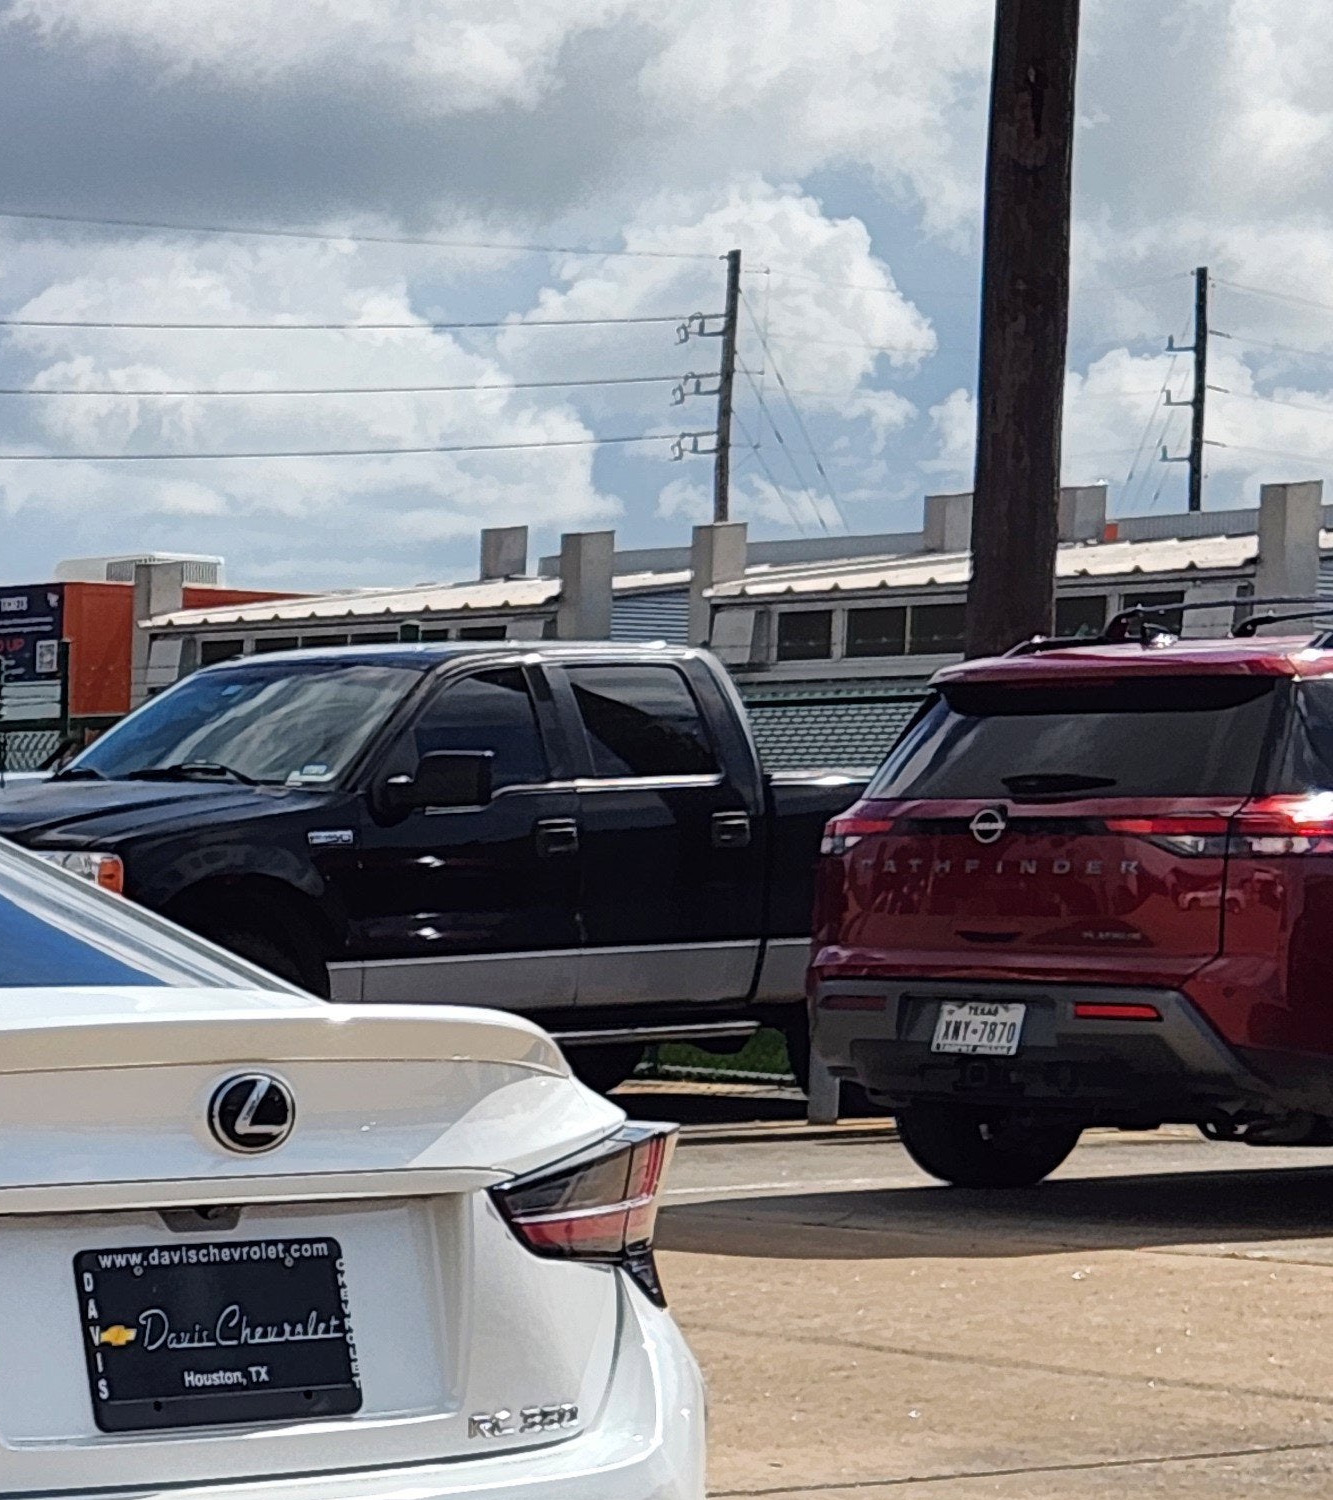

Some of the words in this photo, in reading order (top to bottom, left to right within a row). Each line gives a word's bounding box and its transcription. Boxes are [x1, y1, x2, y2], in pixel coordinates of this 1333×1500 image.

[6, 637, 25, 652] UP
[862, 857, 1139, 875] PATHFINDER
[98, 1242, 329, 1269] www.davischevrolet.com
[83, 1272, 109, 1400] DAVIS
[139, 1308, 216, 1351] Davis
[216, 1304, 344, 1346] Chevrolet
[183, 1370, 247, 1388] Houston,
[248, 1366, 270, 1383] TX
[468, 1408, 514, 1439] RC
